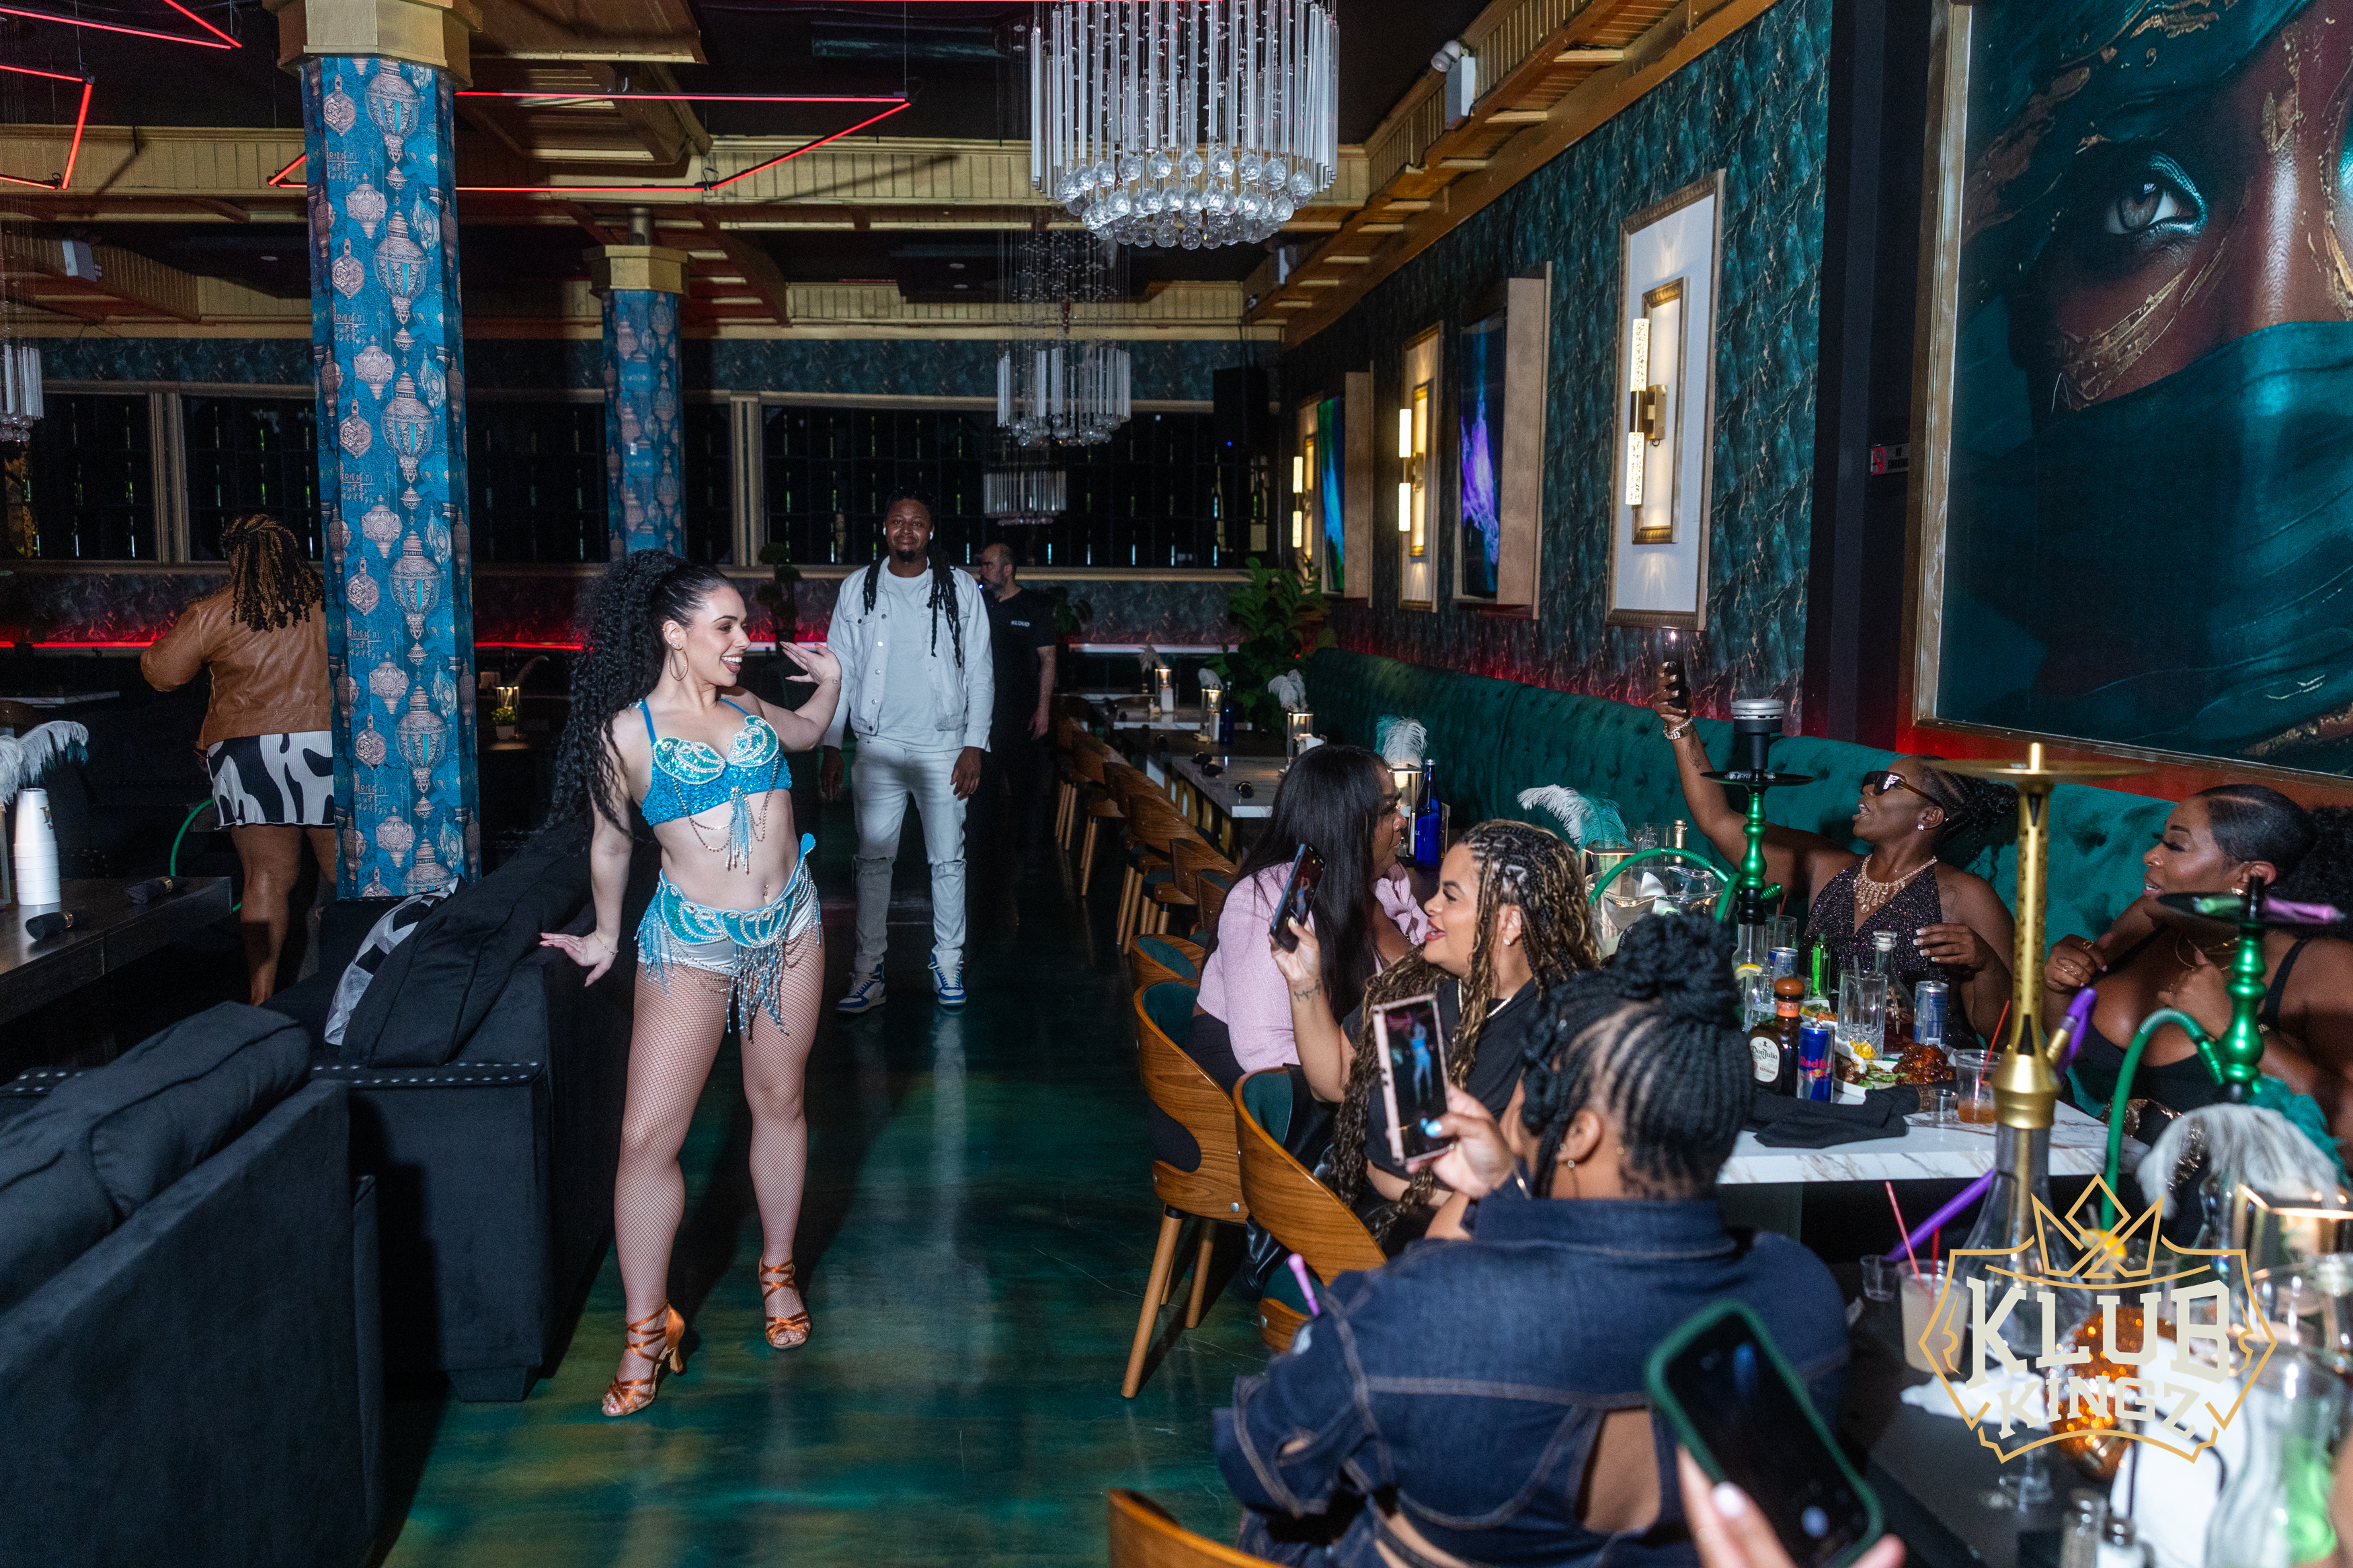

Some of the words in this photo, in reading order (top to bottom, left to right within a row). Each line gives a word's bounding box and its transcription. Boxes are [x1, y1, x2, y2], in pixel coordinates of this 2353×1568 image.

[1751, 1046, 1764, 1055] Don
[1762, 1048, 1778, 1059] Julio
[1800, 1056, 1819, 1068] Red
